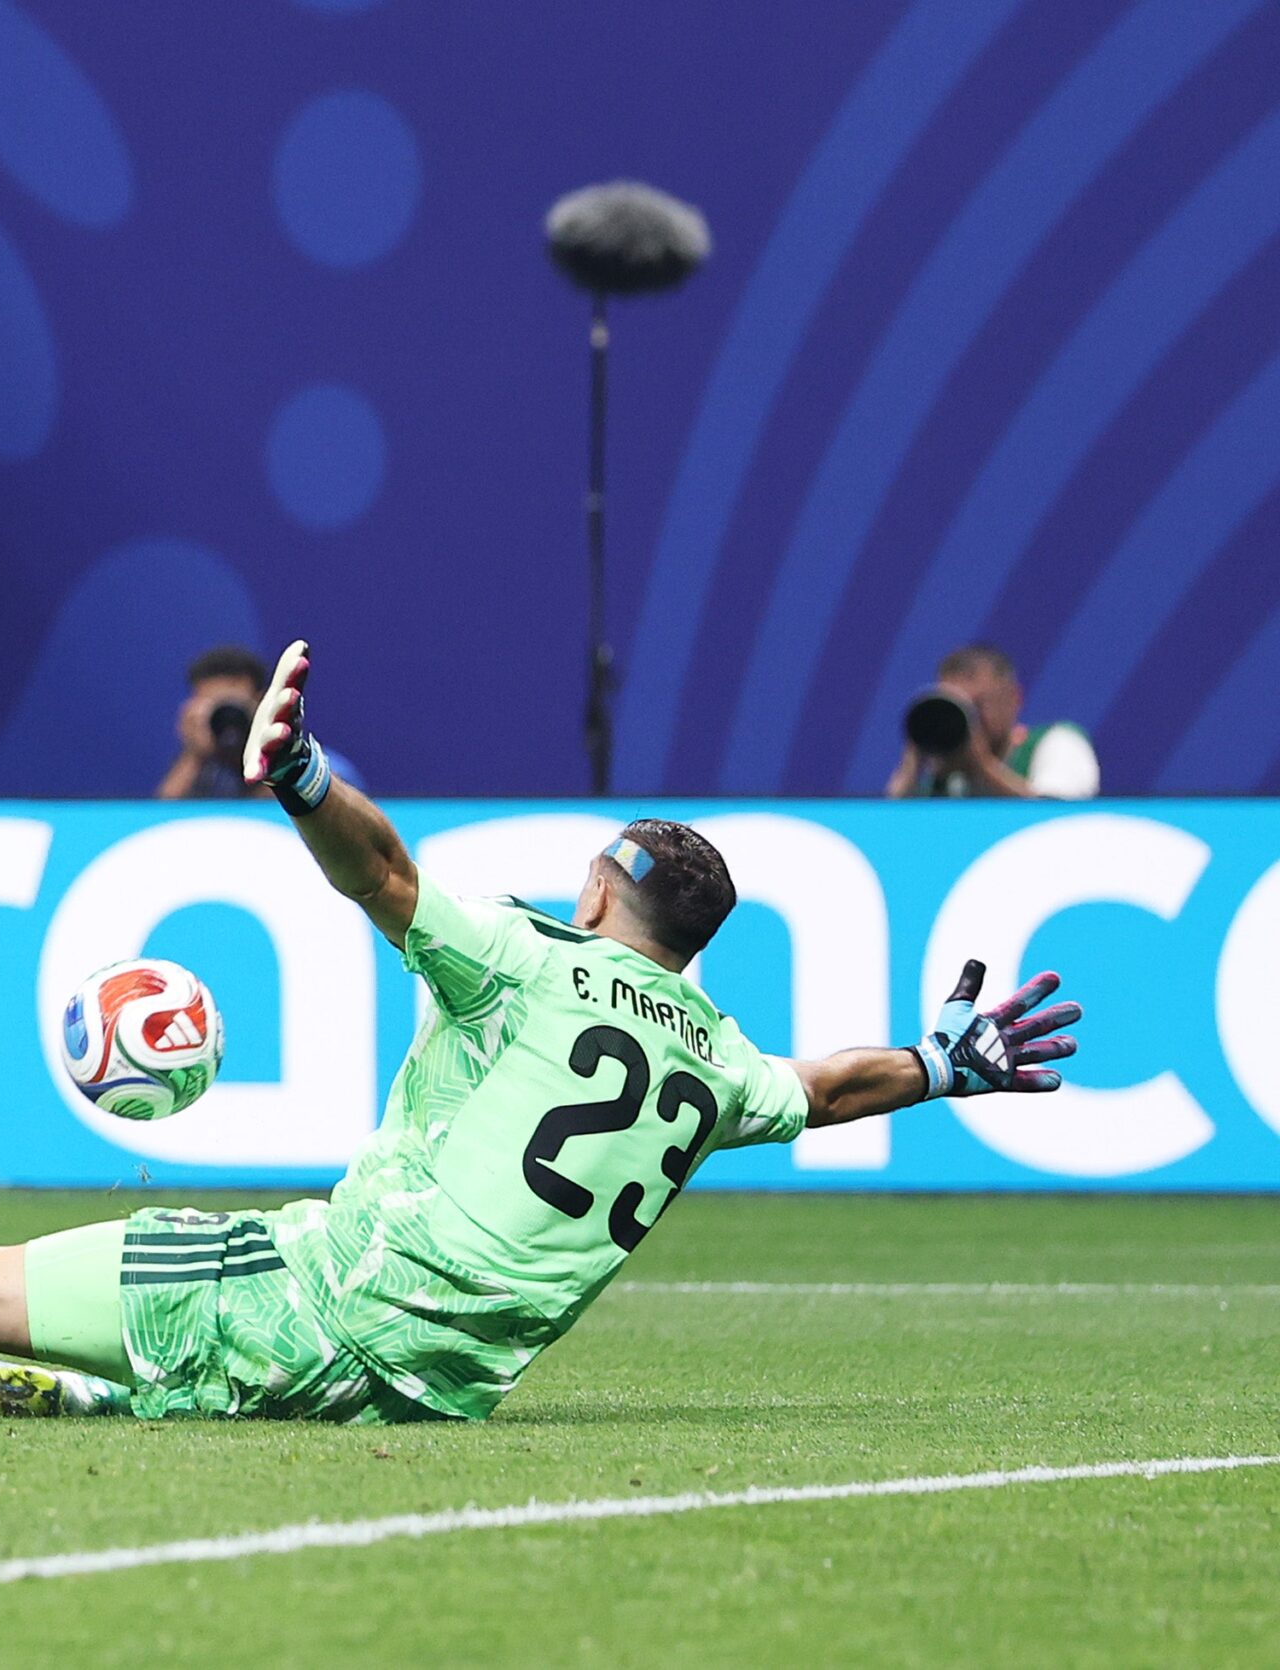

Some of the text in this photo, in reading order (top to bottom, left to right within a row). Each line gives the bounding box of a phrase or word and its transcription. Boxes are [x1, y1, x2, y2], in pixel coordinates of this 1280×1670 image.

[572, 966, 726, 1068] E. MARTNE
[522, 1024, 718, 1253] 23
